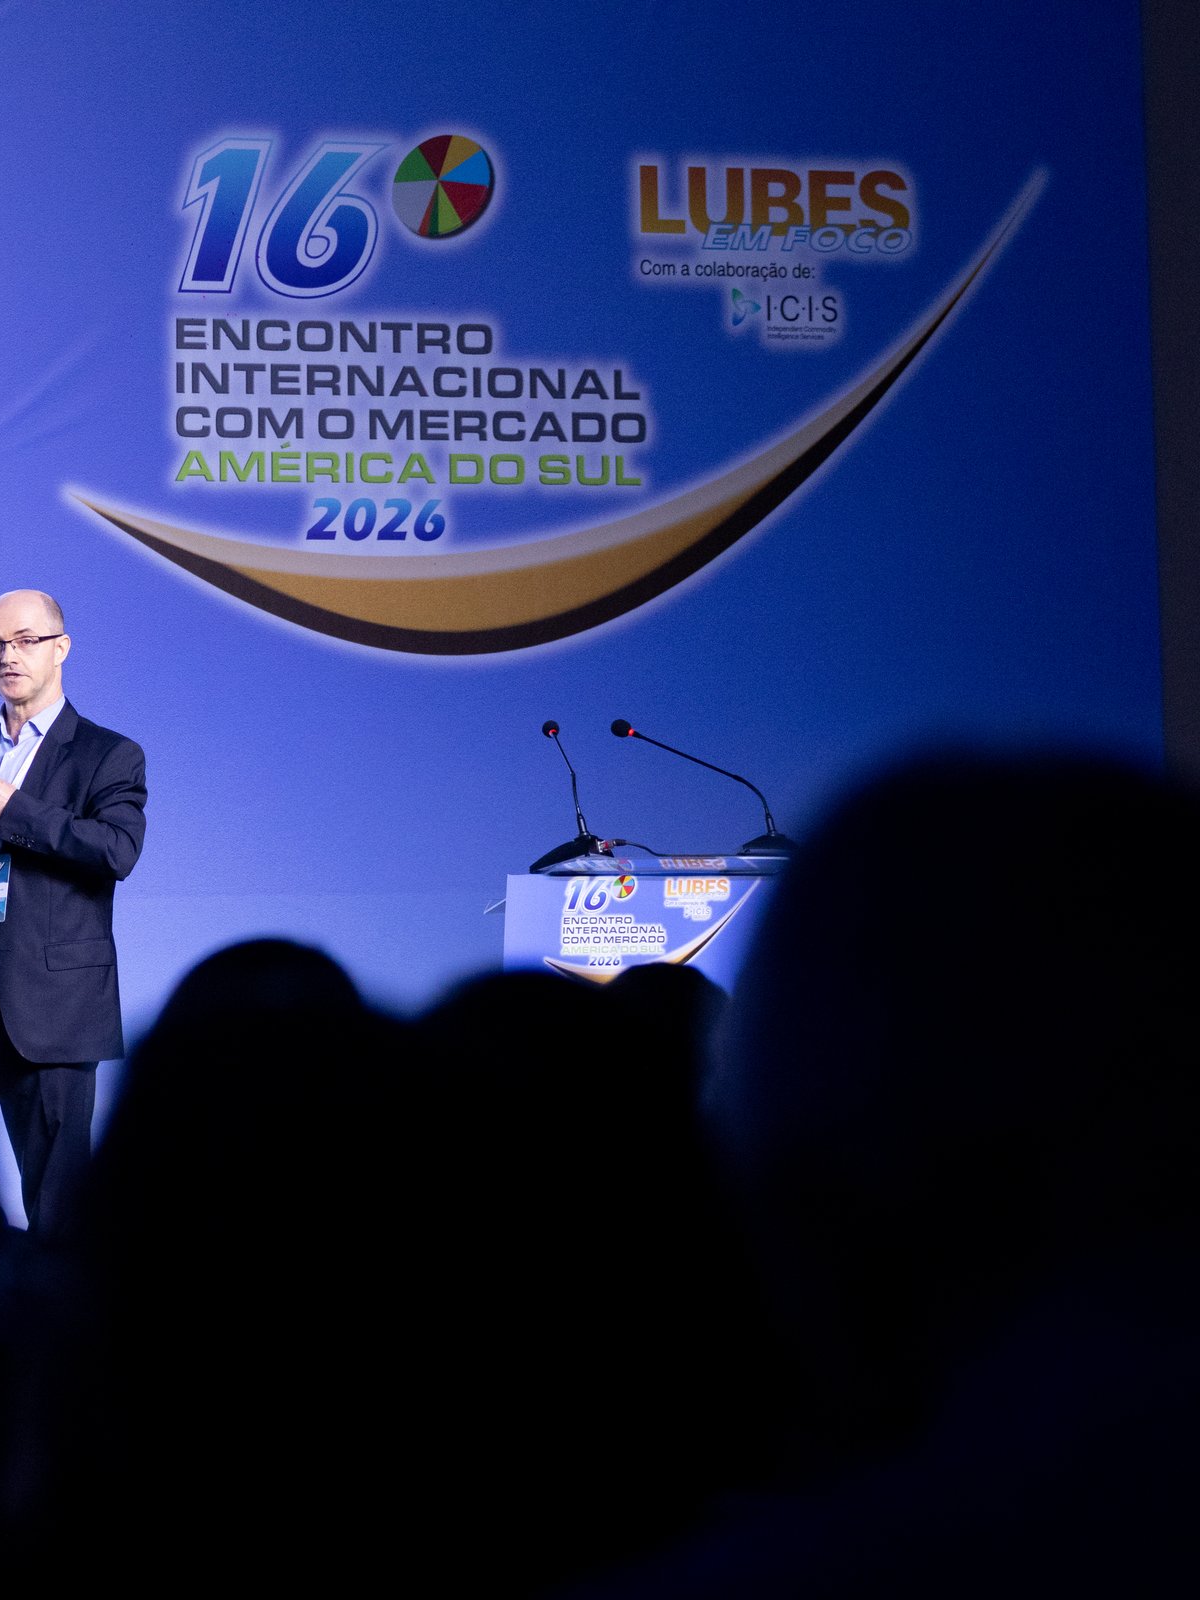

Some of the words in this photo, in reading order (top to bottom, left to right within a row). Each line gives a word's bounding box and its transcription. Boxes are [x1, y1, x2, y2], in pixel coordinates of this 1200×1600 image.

[639, 165, 910, 238] LUBES
[702, 222, 773, 252] EM
[781, 224, 913, 255] FOCO
[640, 259, 676, 277] Com
[681, 264, 690, 277] a
[695, 262, 788, 282] colaboração
[792, 263, 816, 280] de:
[175, 317, 493, 356] ENCONTRO
[175, 362, 641, 401] INTERNACIONAL
[175, 406, 303, 441] COM
[317, 408, 355, 441] O
[368, 409, 647, 444] MERCADO
[174, 440, 436, 485] AMÉRICA
[449, 453, 526, 485] DO
[538, 454, 642, 486] SUL
[306, 498, 447, 542] 2026
[666, 878, 728, 897] LUBES
[562, 926, 664, 935] INTERNACIONAL
[563, 916, 633, 925] ENCONTRO
[562, 936, 590, 944] COM
[592, 936, 601, 944] O
[603, 935, 666, 944] MERCADO
[620, 945, 638, 953] DO
[640, 945, 664, 953] SUL
[589, 956, 620, 966] 2026
